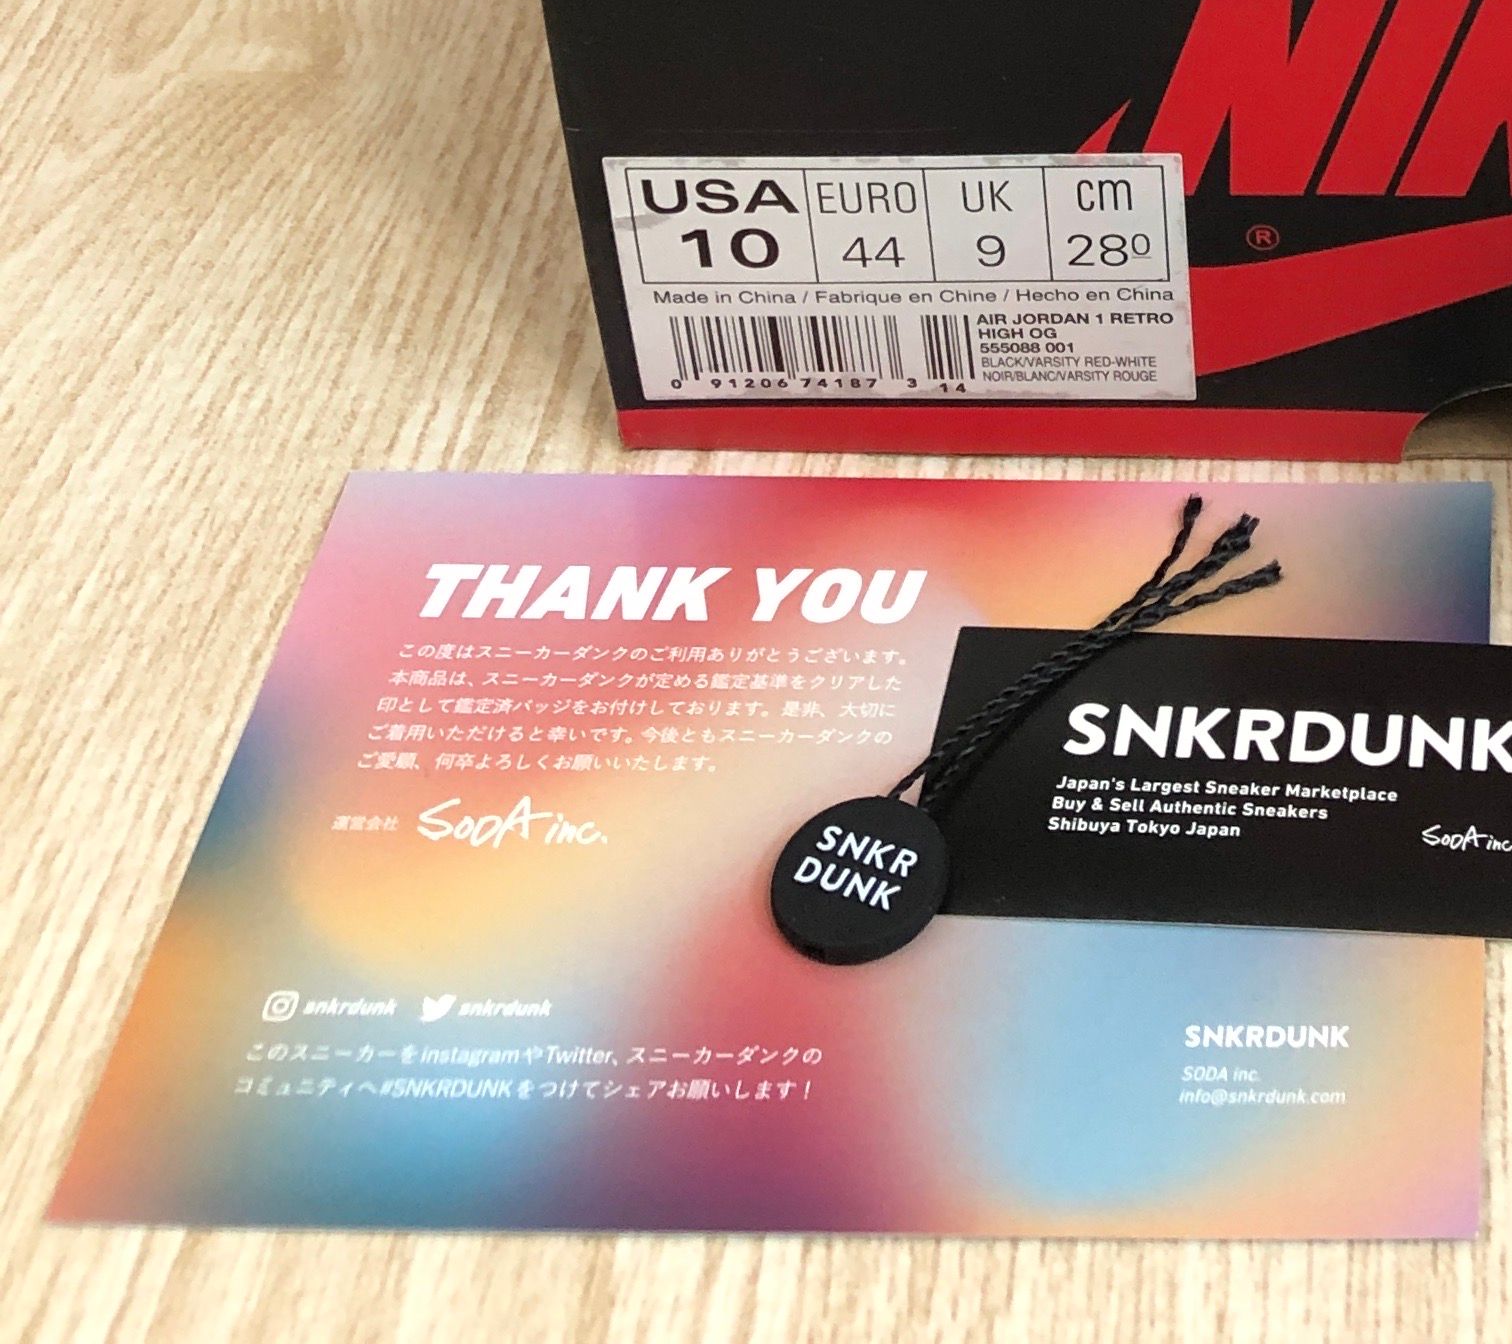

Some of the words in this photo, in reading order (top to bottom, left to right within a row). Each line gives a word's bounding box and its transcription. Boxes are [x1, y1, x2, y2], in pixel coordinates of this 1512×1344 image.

[640, 179, 800, 214] USA
[816, 181, 917, 214] EURO
[961, 180, 1014, 213] UK
[1076, 179, 1133, 212] cm
[681, 228, 780, 269] 10
[842, 236, 905, 268] 44
[976, 235, 1006, 267] 9
[653, 291, 709, 304] Made
[715, 291, 732, 304] in
[738, 290, 796, 304] China
[815, 290, 902, 307] Fabrique
[909, 292, 933, 303] en
[939, 289, 997, 303] Chine
[1016, 288, 1080, 302] Hecho
[1086, 291, 1110, 302] en
[1116, 287, 1175, 302] China
[976, 314, 1007, 325] AIR
[1012, 313, 1089, 325] JORDAN
[1110, 313, 1174, 324] RETRO
[978, 328, 1024, 339] HIGH
[1029, 328, 1058, 340] OG
[980, 343, 1040, 354] 555088
[1045, 343, 1075, 354] 001
[981, 356, 1080, 368] BLACK/VARSITY
[1085, 356, 1157, 367] RED-WHITE
[671, 379, 682, 389] 0
[907, 378, 917, 388] 3
[983, 370, 1108, 382] NOIR/BLANC/VARSITY
[1113, 370, 1158, 382] ROUGE
[419, 563, 732, 622] THANK
[752, 568, 928, 624] YOU
[1056, 775, 1126, 794] Japan's
[1130, 778, 1200, 796] Largest
[1204, 781, 1281, 796] Sneaker
[1285, 784, 1399, 803] Marketplace
[1052, 796, 1086, 812] Buy
[1091, 797, 1104, 811] &
[1109, 798, 1145, 812] Sell
[1149, 800, 1237, 816] Authentic
[1242, 803, 1328, 819] Sneakers
[1048, 817, 1121, 833] Shibuya
[1127, 819, 1181, 837] Tokyo
[1186, 822, 1241, 838] Japan
[816, 825, 918, 878] SNKR
[794, 856, 902, 911] DUNK
[303, 998, 398, 1016] snkrdunk
[458, 999, 553, 1017] snkrdunk
[1184, 1025, 1350, 1049] SNKRDUNK
[1181, 1066, 1228, 1082] SODA
[1233, 1066, 1260, 1082] inc.
[1178, 1088, 1346, 1105] info@snkrdunk.com
